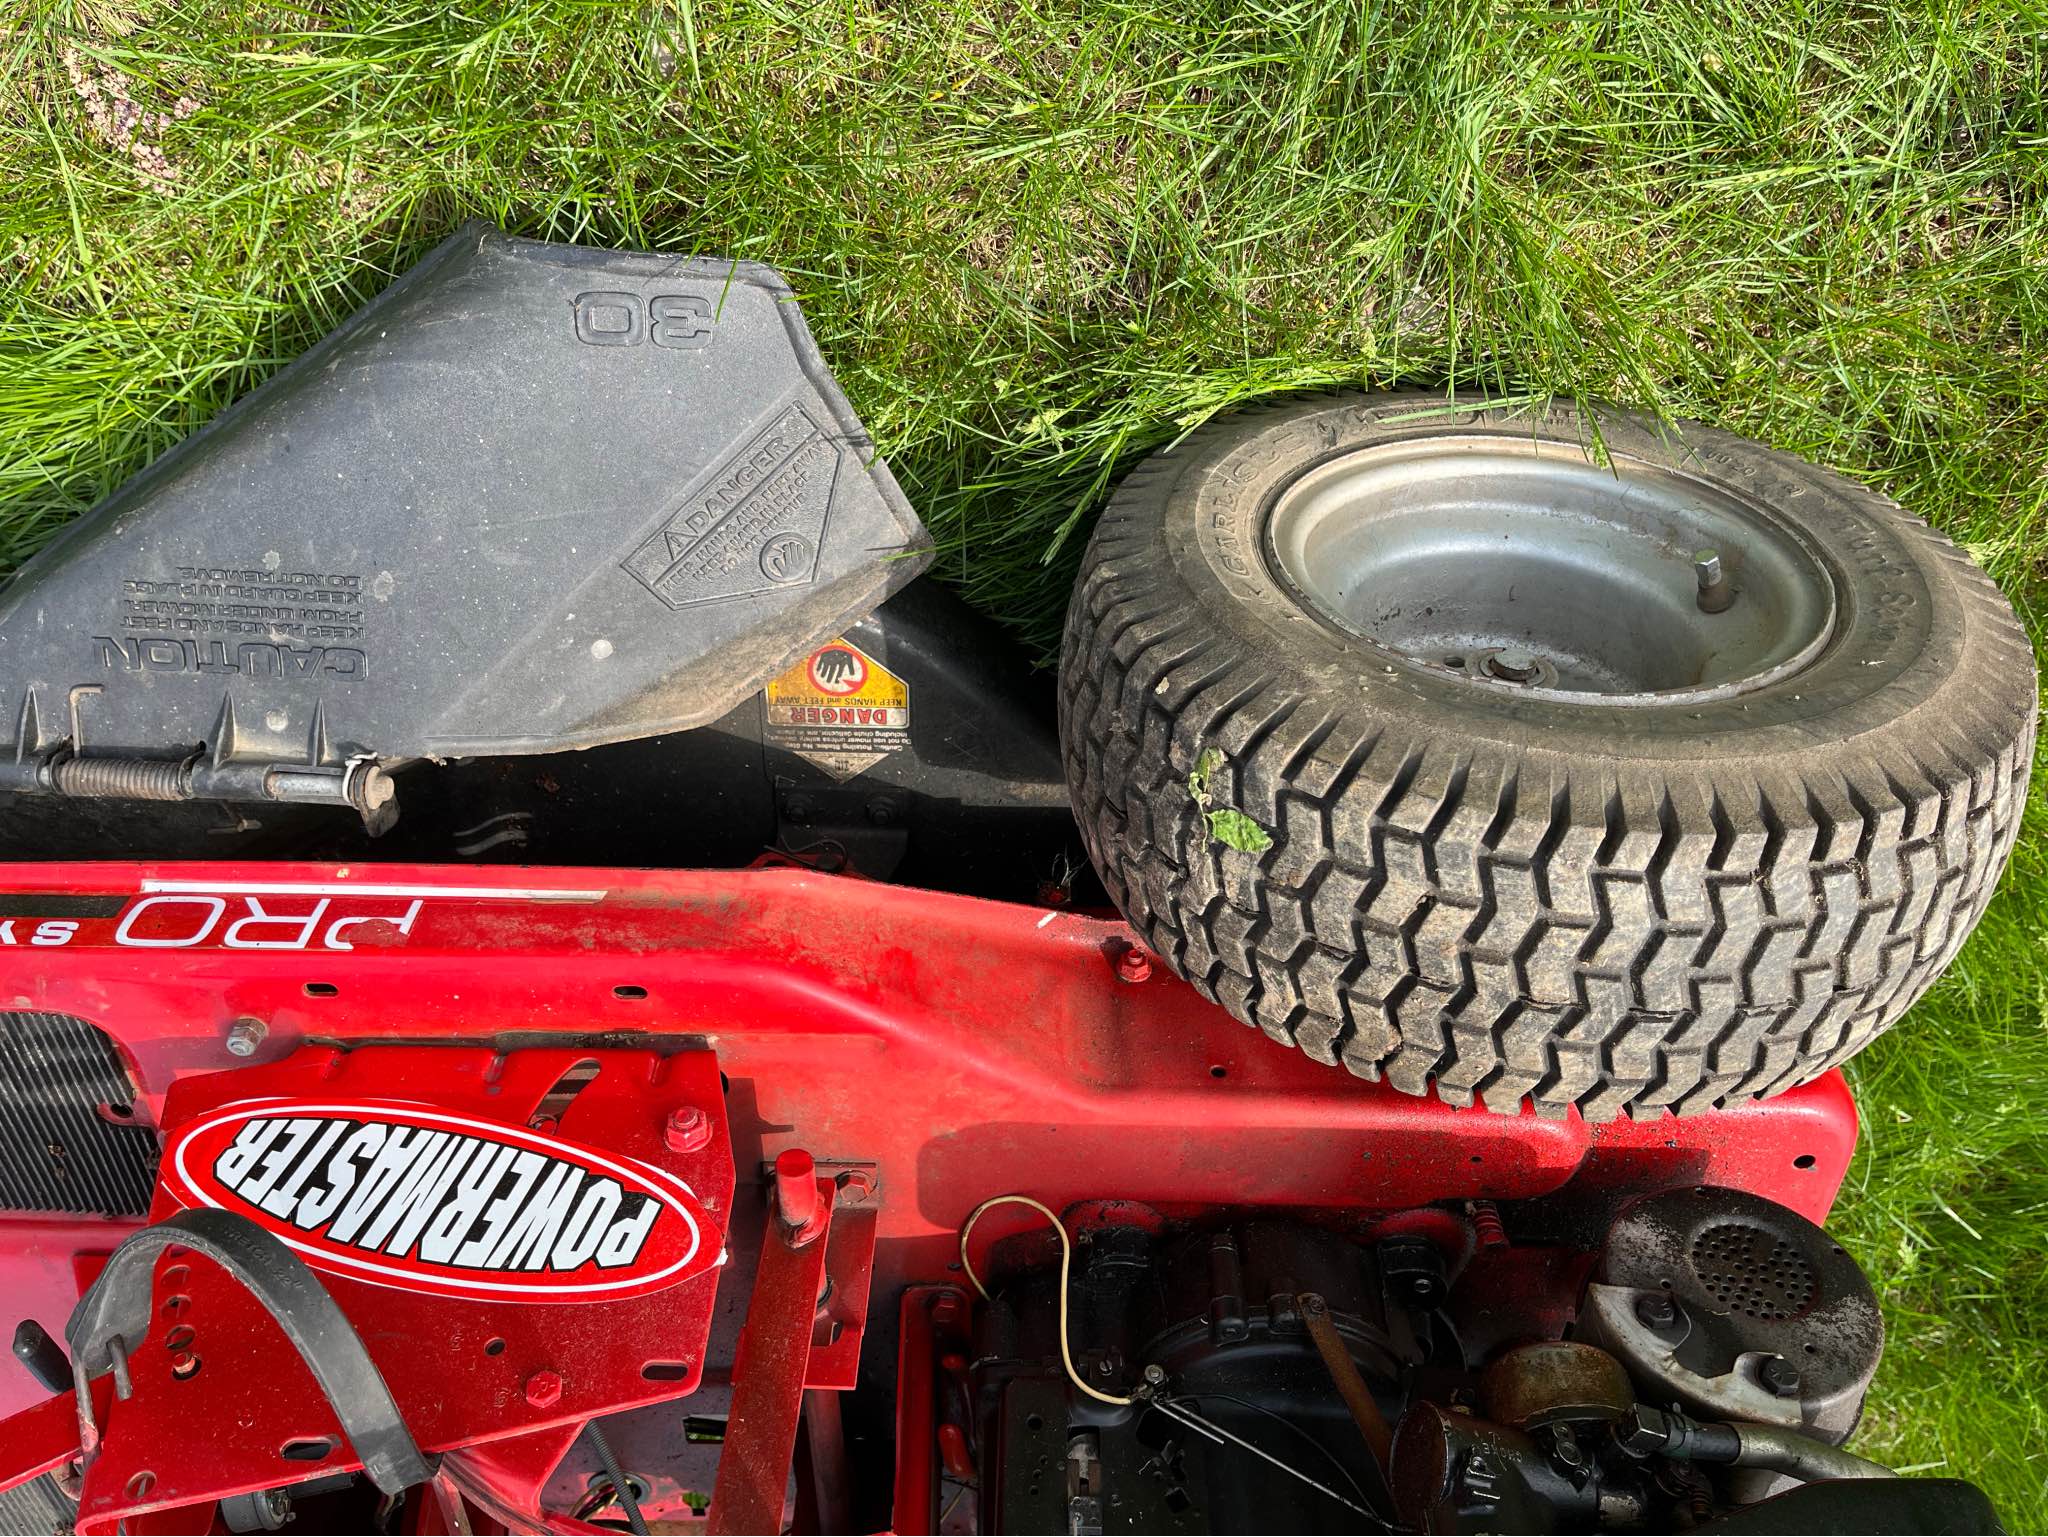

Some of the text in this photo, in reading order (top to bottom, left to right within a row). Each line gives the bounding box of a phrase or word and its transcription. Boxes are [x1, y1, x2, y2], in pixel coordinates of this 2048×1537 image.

[574, 291, 712, 350] 30
[685, 437, 790, 535] DANGER
[695, 522, 738, 562] HANDS
[736, 497, 762, 526] AND
[723, 516, 762, 555] GUARD
[122, 580, 362, 605] KEEP GUARD IN PLACE
[277, 573, 325, 587] NOT
[326, 575, 362, 590] DO
[216, 604, 295, 620] UNDER
[301, 607, 364, 624] FROM
[119, 614, 365, 640] KEEP HANDS AND FEET
[91, 636, 369, 682] CAUTION
[774, 695, 903, 708] KEEP HANDS and FEET AWAY
[791, 707, 888, 725] DANGER
[115, 895, 425, 951] PRO
[214, 1117, 662, 1271] POWERMASTER
